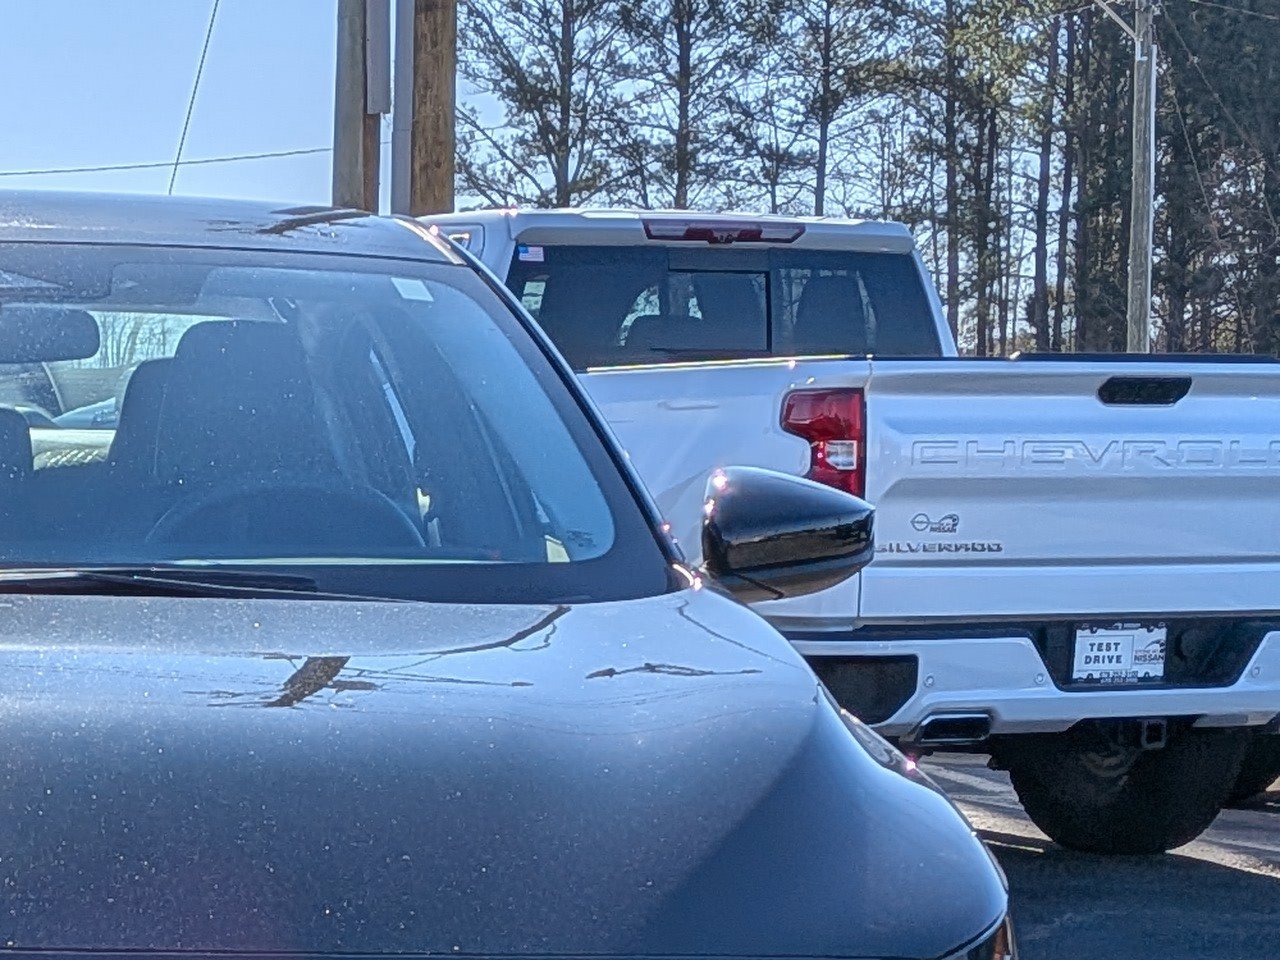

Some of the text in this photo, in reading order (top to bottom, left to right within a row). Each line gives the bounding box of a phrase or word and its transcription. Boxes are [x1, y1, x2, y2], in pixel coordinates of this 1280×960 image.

[874, 542, 1003, 553] SILVERADO
[1088, 642, 1121, 652] TEST
[1084, 654, 1123, 665] DRIVE
[1133, 654, 1165, 662] NISSAN
